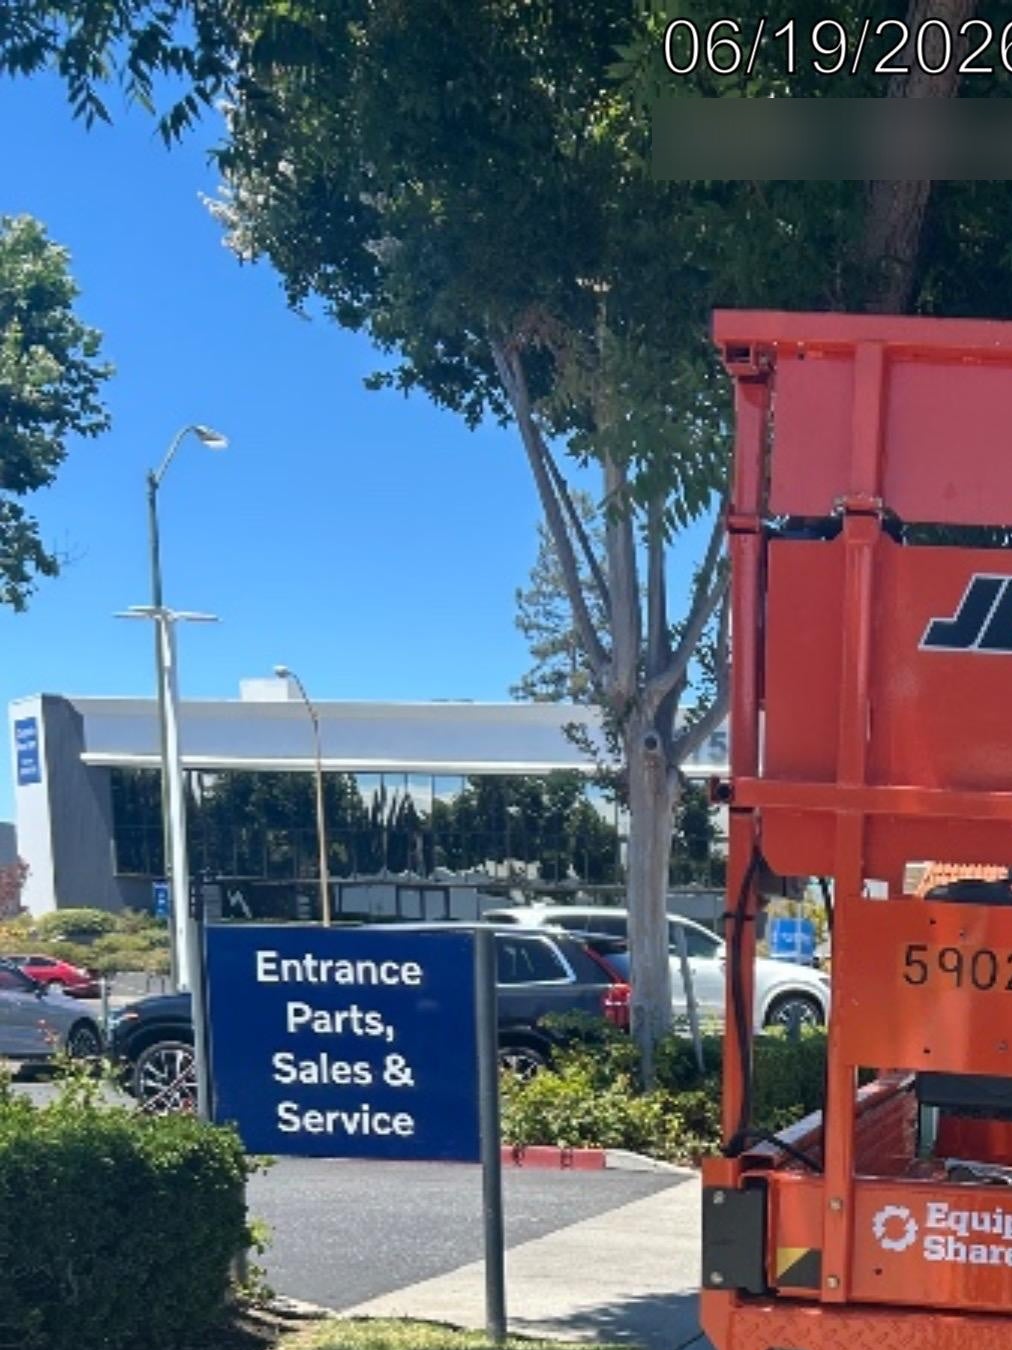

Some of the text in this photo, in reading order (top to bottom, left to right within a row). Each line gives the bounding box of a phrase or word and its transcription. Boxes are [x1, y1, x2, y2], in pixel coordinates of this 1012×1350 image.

[255, 950, 423, 986] Entrance
[286, 1001, 395, 1042] Parts,
[271, 1052, 415, 1087] Sales &
[276, 1101, 416, 1136] Service
